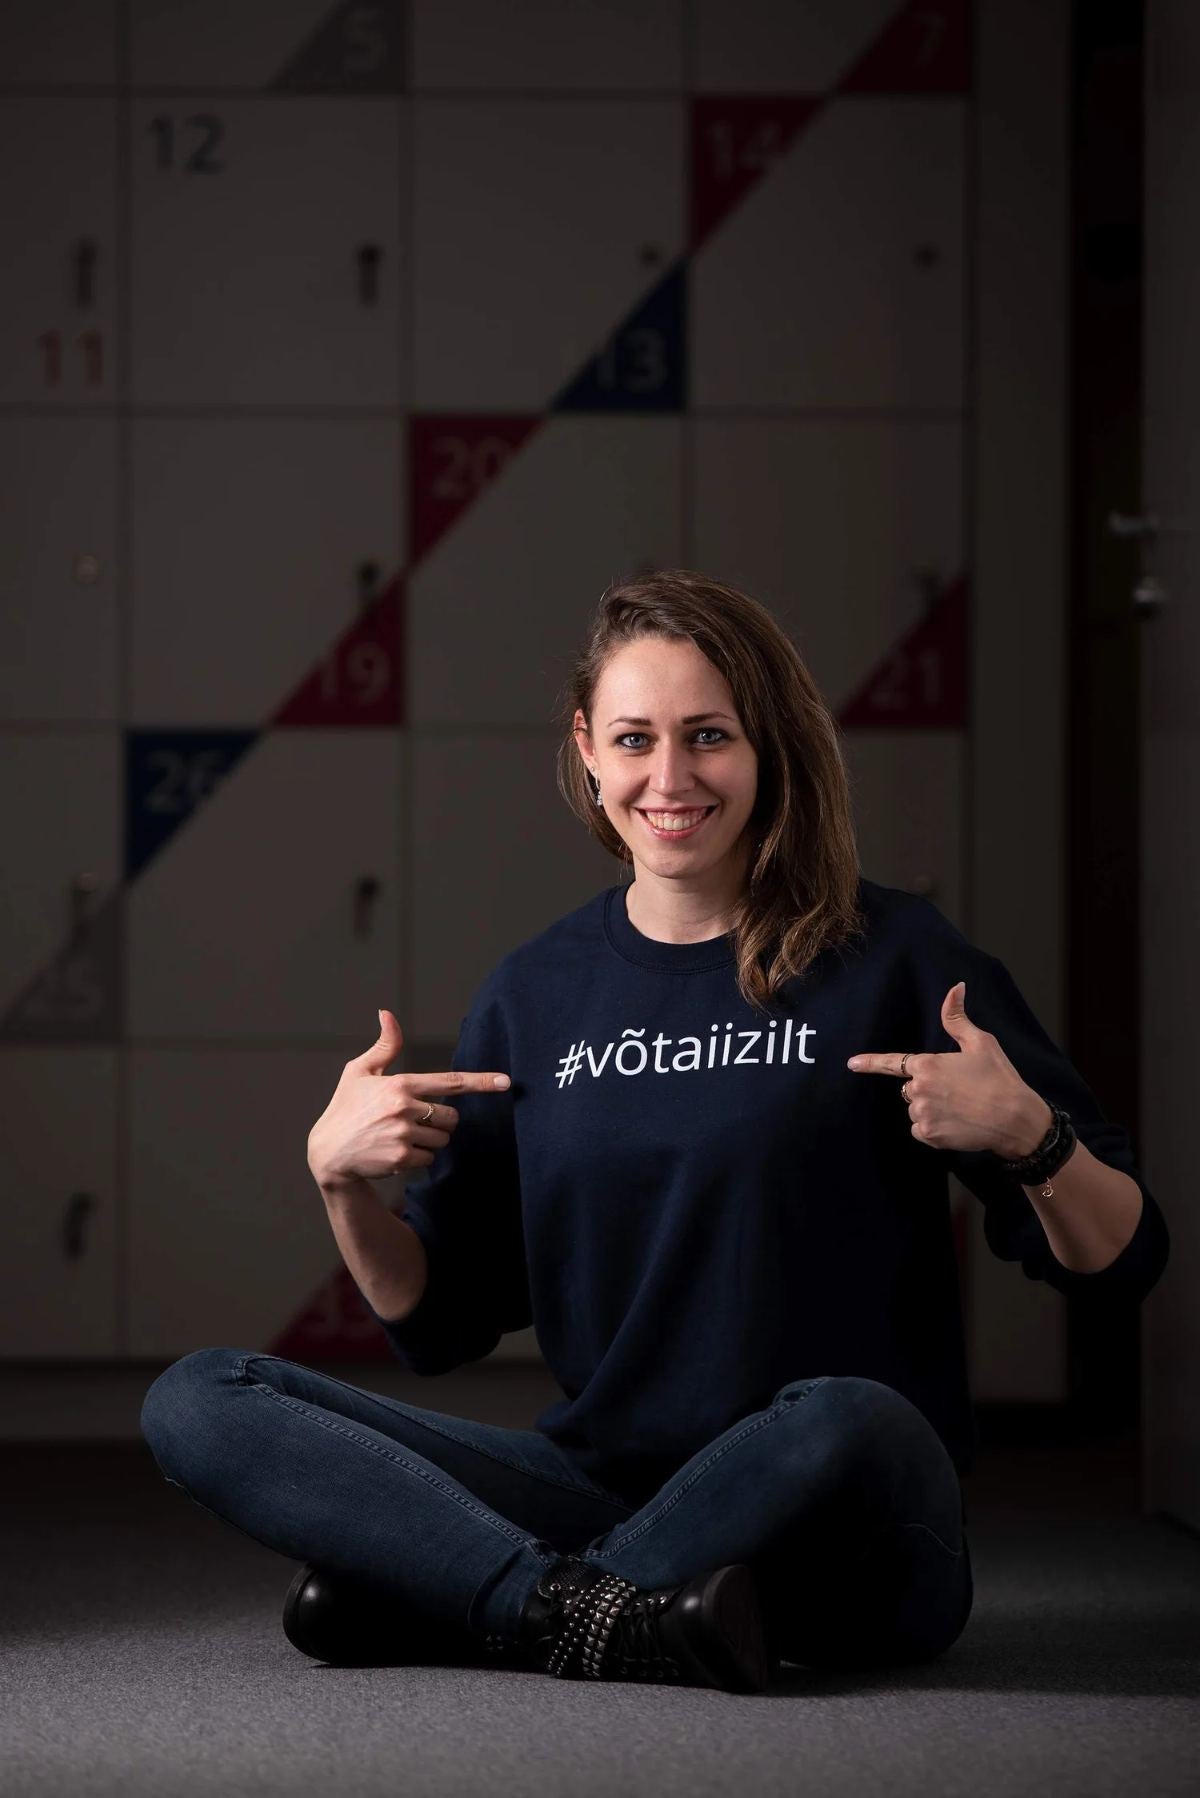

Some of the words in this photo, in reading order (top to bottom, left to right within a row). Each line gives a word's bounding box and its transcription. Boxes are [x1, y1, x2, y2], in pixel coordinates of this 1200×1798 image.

[343, 8, 387, 72] 5
[911, 9, 946, 68] 7
[147, 113, 225, 174] 12
[707, 120, 786, 182] 14
[37, 330, 102, 387] 11
[594, 328, 668, 393] 13
[430, 435, 512, 500] 20
[319, 640, 390, 706] 19
[869, 647, 943, 710] 21
[555, 1019, 816, 1089] #võtaiizilt
